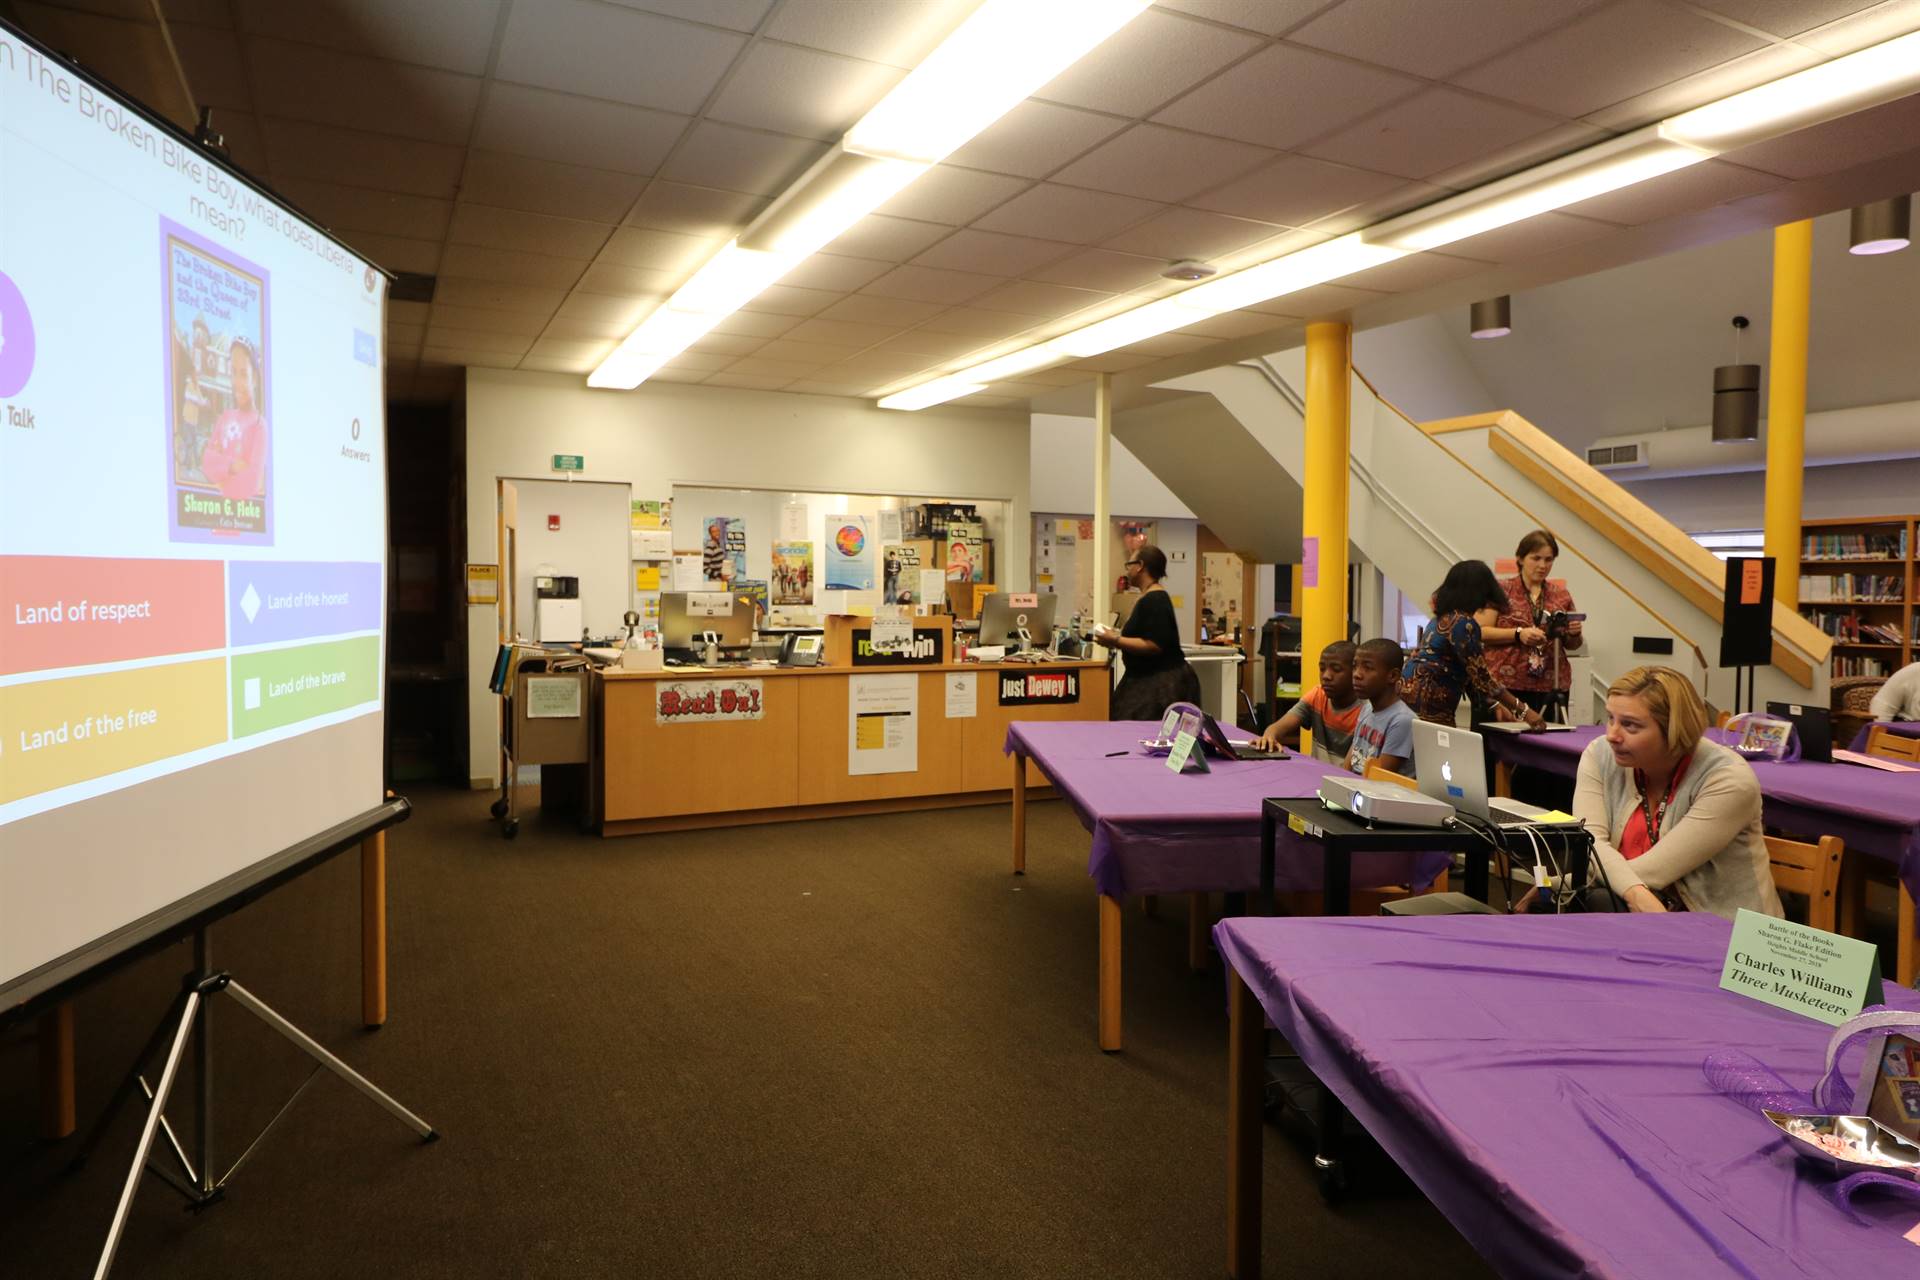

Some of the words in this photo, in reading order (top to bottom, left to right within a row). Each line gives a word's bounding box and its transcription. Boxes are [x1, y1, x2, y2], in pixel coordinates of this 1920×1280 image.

[21, 45, 71, 104] The
[79, 83, 156, 157] Broken
[163, 138, 201, 184] Bike
[207, 166, 240, 209] Boy,
[243, 194, 281, 233] what
[282, 218, 313, 251] does
[316, 235, 353, 274] Liberia
[190, 195, 246, 240] mean?
[7, 404, 35, 430] Talk
[352, 418, 360, 441] 0
[341, 444, 371, 463] Answers
[184, 493, 221, 515] Sharon
[224, 499, 234, 516] G.
[237, 500, 261, 519] Flake
[15, 600, 63, 625] Land
[68, 600, 87, 621] of
[92, 599, 151, 624] respect
[268, 592, 293, 609] Land
[294, 592, 303, 607] of
[304, 592, 320, 606] the
[321, 591, 350, 606] honest
[269, 676, 294, 698] Land
[295, 675, 304, 692] of
[305, 673, 320, 689] the
[322, 671, 346, 687] brave
[1002, 678, 1025, 698] Just
[1028, 675, 1065, 697] Dewey
[1067, 674, 1076, 696] It
[660, 690, 717, 716] Read
[720, 688, 760, 713] On!
[20, 721, 69, 752] Land
[73, 717, 92, 740] of
[96, 714, 124, 736] the
[128, 709, 157, 729] free
[1757, 928, 1782, 942] Sharon
[1783, 936, 1791, 944] G.
[1793, 939, 1813, 951] Flake
[1815, 944, 1842, 959] Edition
[1768, 923, 1788, 934] Battle
[1790, 929, 1799, 937] of
[1799, 931, 1811, 940] the
[1812, 935, 1834, 948] Books
[1734, 951, 1786, 977] Charles
[1790, 968, 1854, 1000] Williams
[1730, 968, 1768, 990] Three
[1770, 982, 1849, 1017] Musketeers
